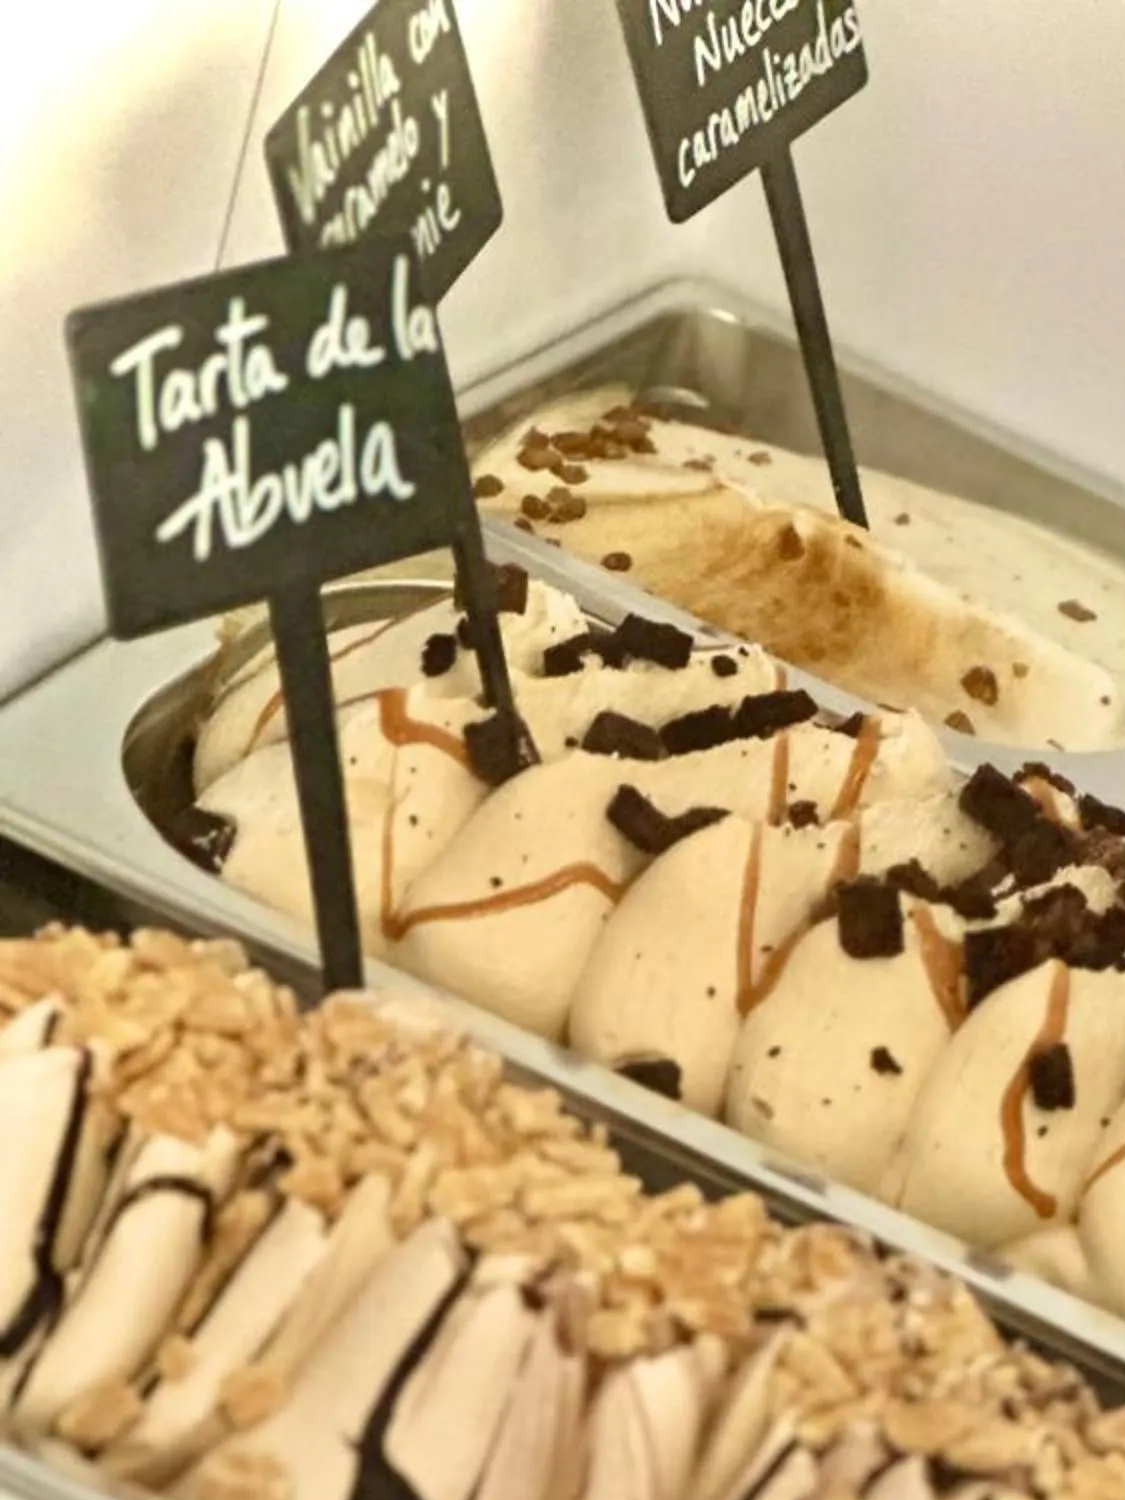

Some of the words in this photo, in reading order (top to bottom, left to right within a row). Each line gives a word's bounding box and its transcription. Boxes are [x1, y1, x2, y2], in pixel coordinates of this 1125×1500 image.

[110, 297, 289, 451] Tarta
[306, 283, 386, 378] de
[393, 254, 438, 360] la
[155, 402, 416, 562] Abuela
